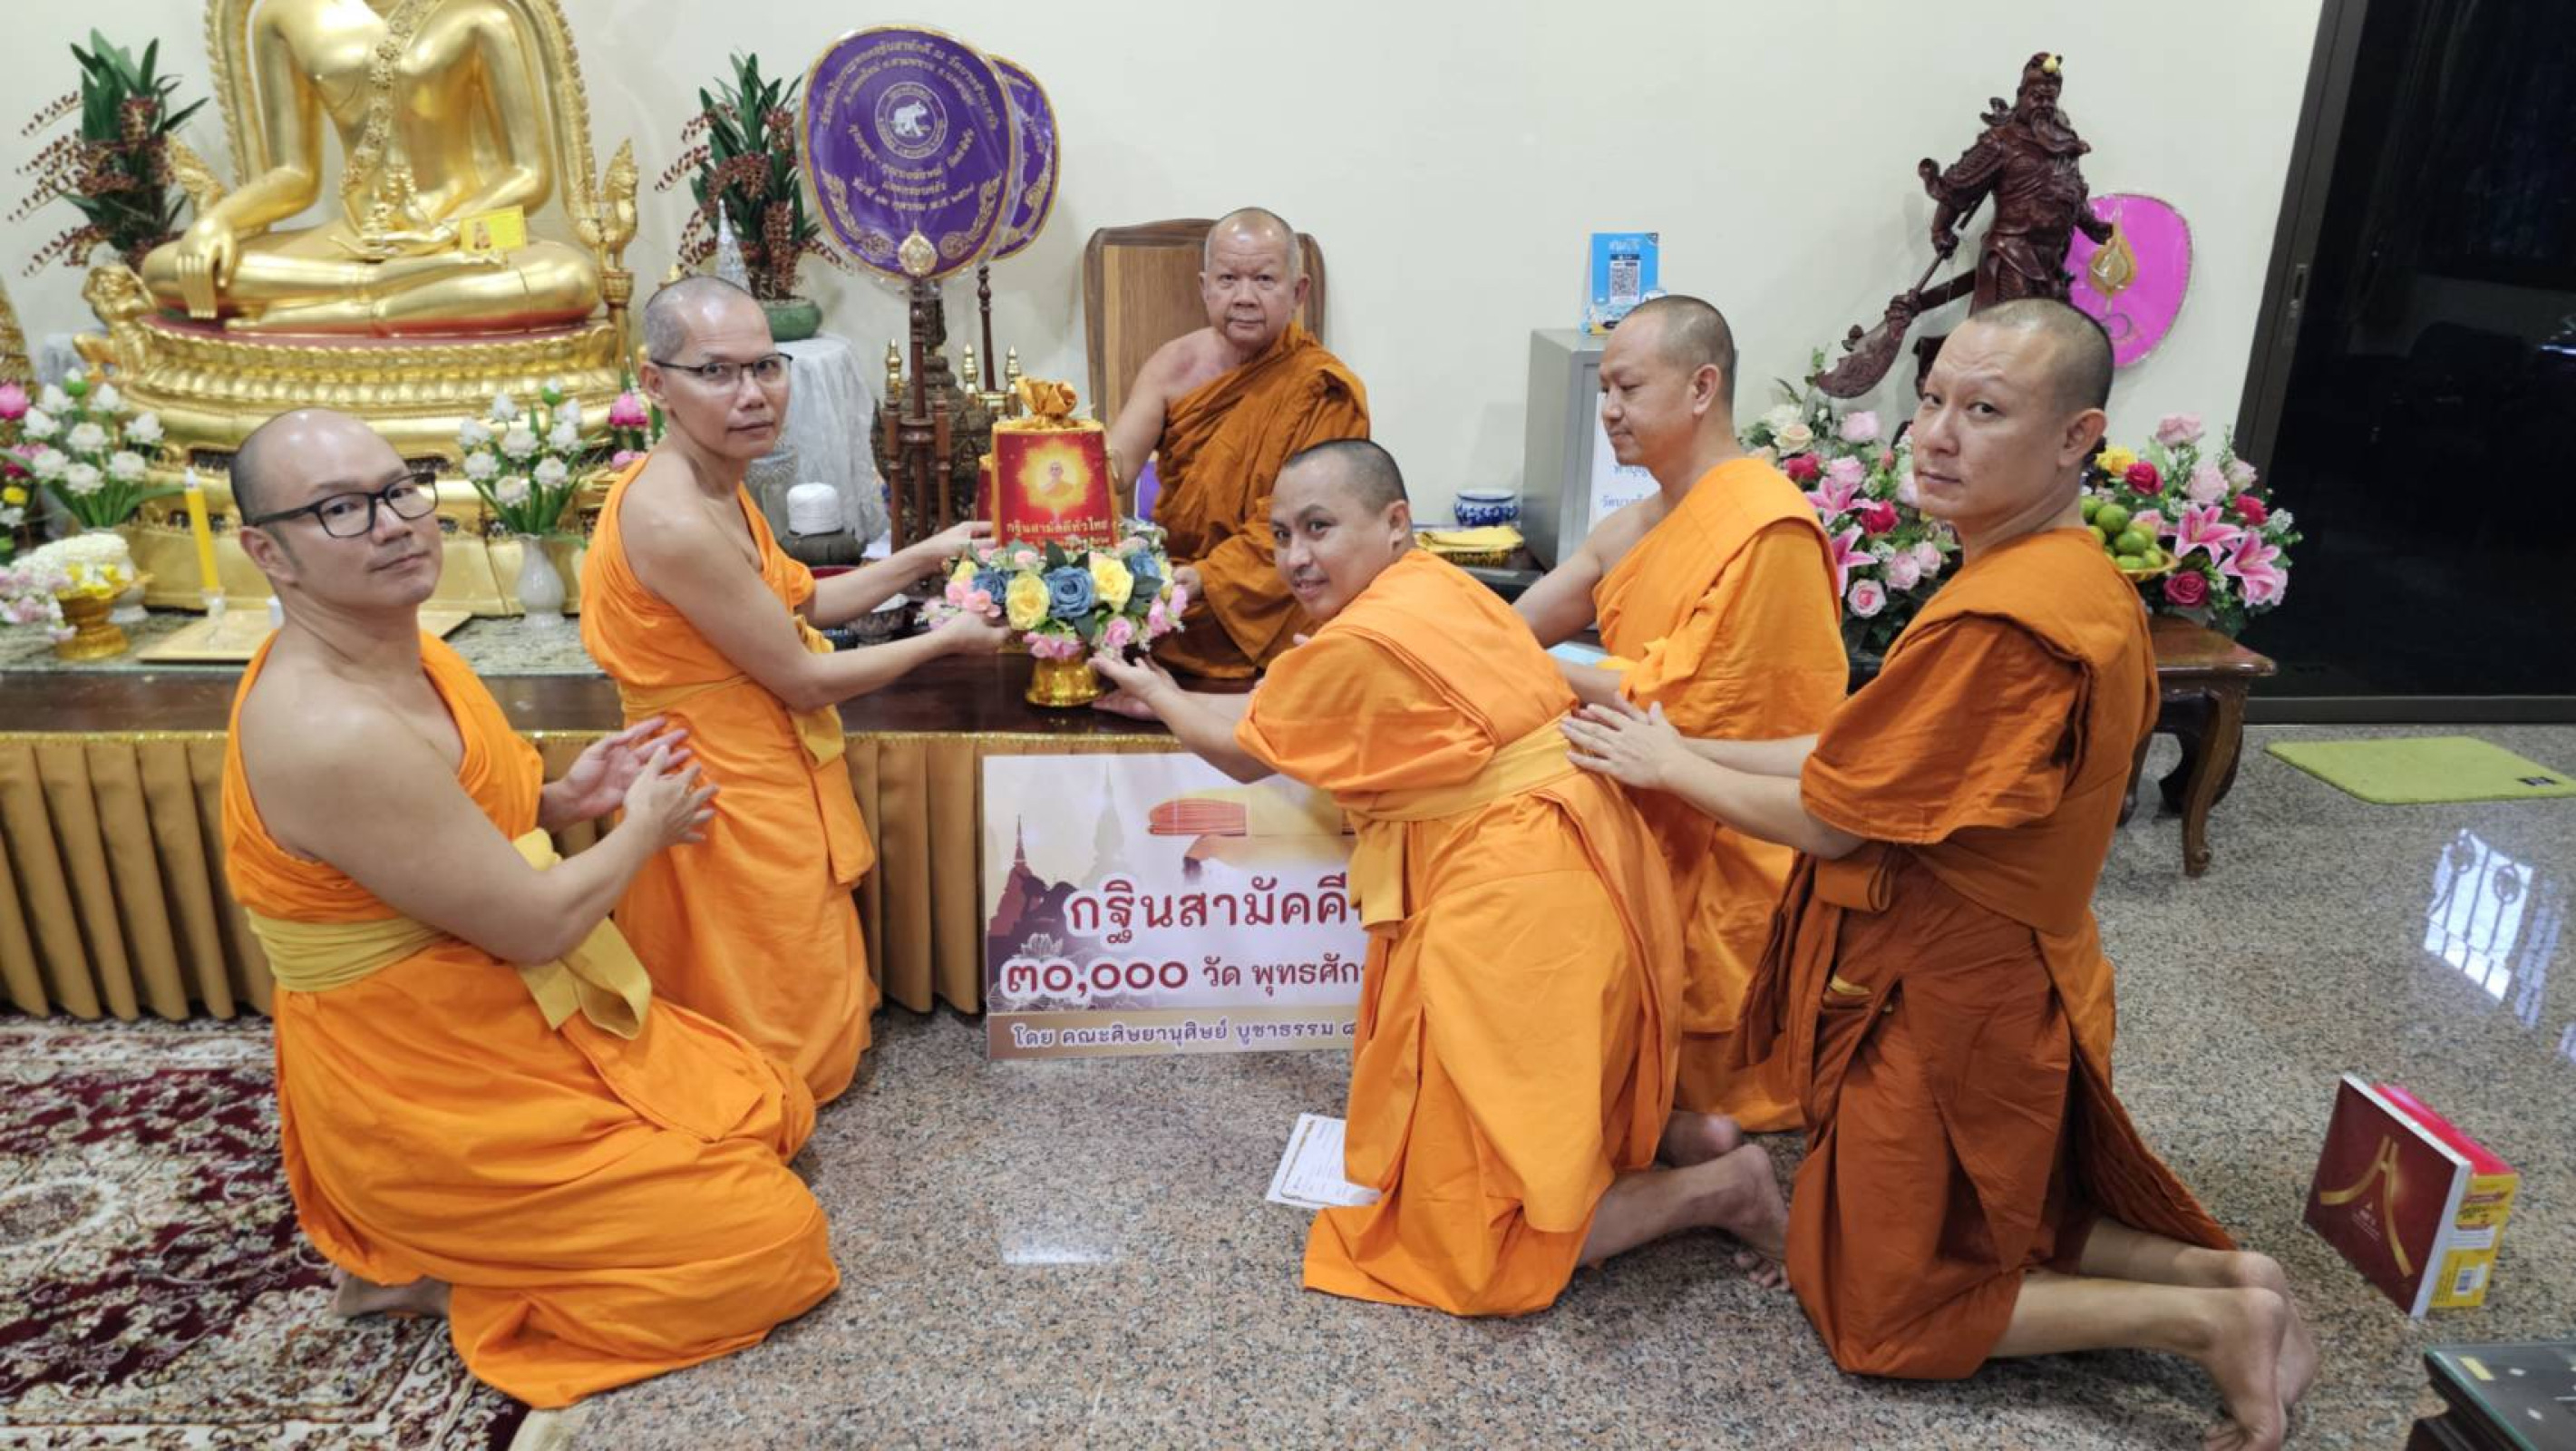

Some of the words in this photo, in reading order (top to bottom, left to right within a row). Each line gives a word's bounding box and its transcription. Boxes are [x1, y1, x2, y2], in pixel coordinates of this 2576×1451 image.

[1068, 872, 1362, 944] กฐินสามัคคี
[1006, 960, 1188, 994] ๓๐,๐๐๐
[1203, 957, 1241, 986] วัด
[1251, 955, 1365, 998] พุทธศัก
[1013, 1025, 1053, 1047] โดย
[1062, 1019, 1228, 1047] คณะศิษยานุศิษย์
[1238, 1022, 1334, 1045] บูชาธรรม
